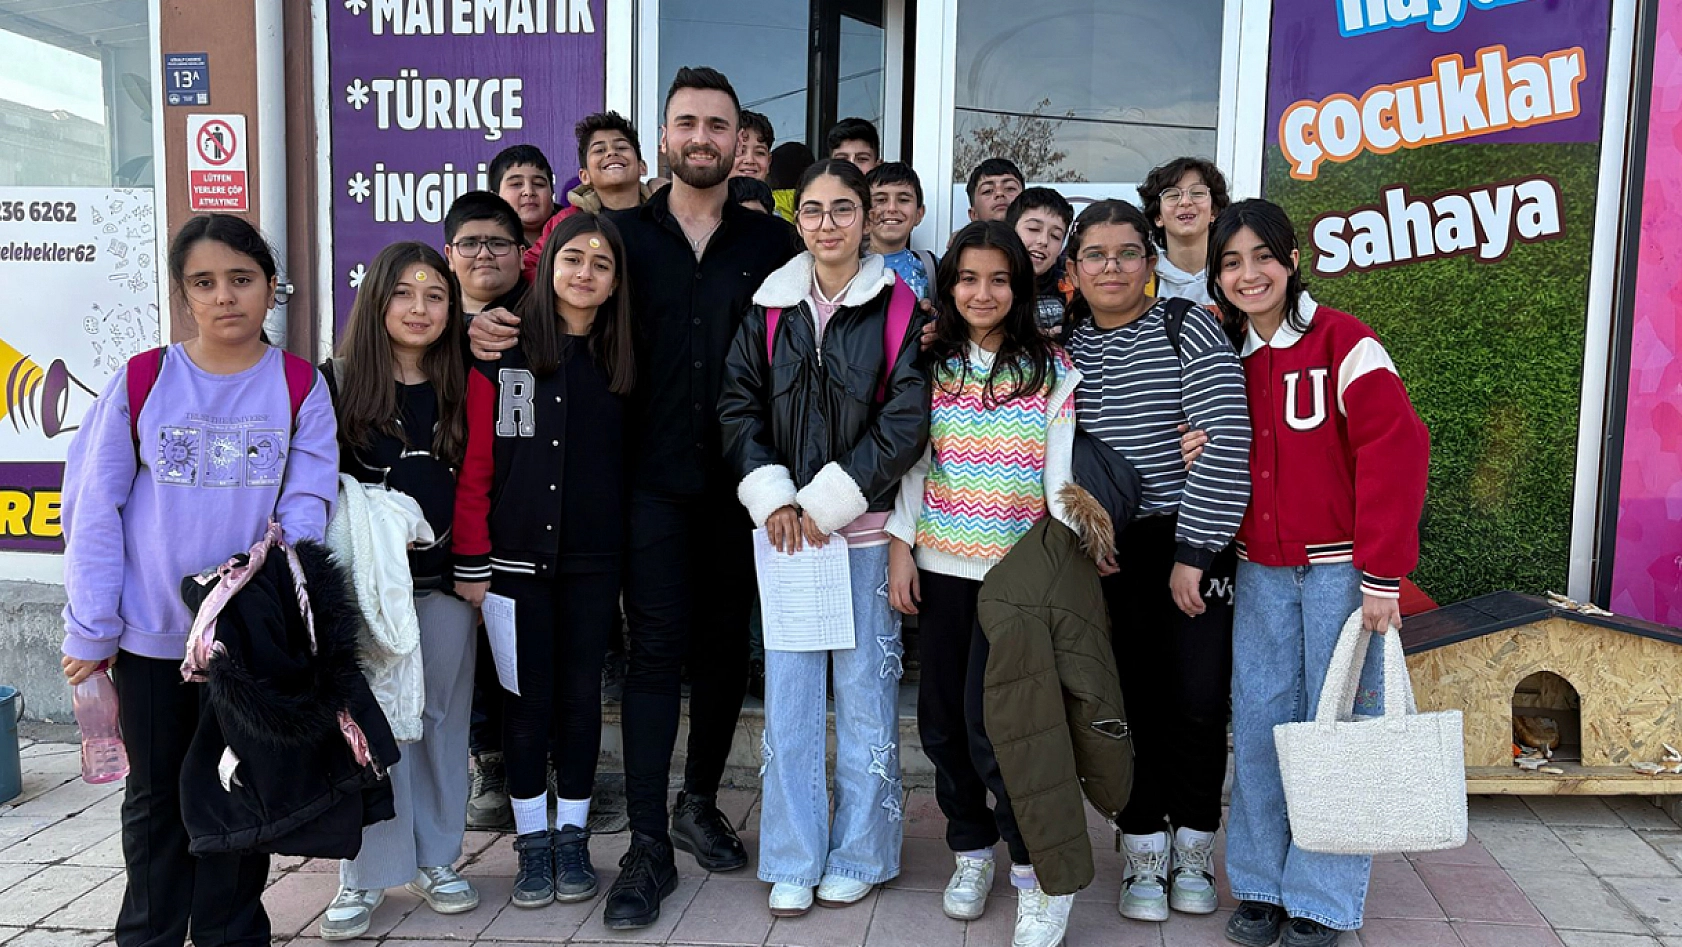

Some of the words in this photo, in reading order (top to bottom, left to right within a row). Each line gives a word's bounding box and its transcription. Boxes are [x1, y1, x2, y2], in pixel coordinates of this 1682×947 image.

[1284, 49, 1582, 176] çocuklar
[203, 173, 232, 182] LÜTFEN
[194, 185, 226, 194] YERLERE
[228, 184, 243, 195] ÇÖP
[0, 201, 25, 222] 36
[29, 201, 77, 222] 6262
[199, 197, 239, 207] ATMAYINIZ
[1312, 178, 1561, 274] sahaya
[0, 241, 97, 262] elebekler62
[496, 368, 535, 437] R
[1282, 367, 1330, 432] U
